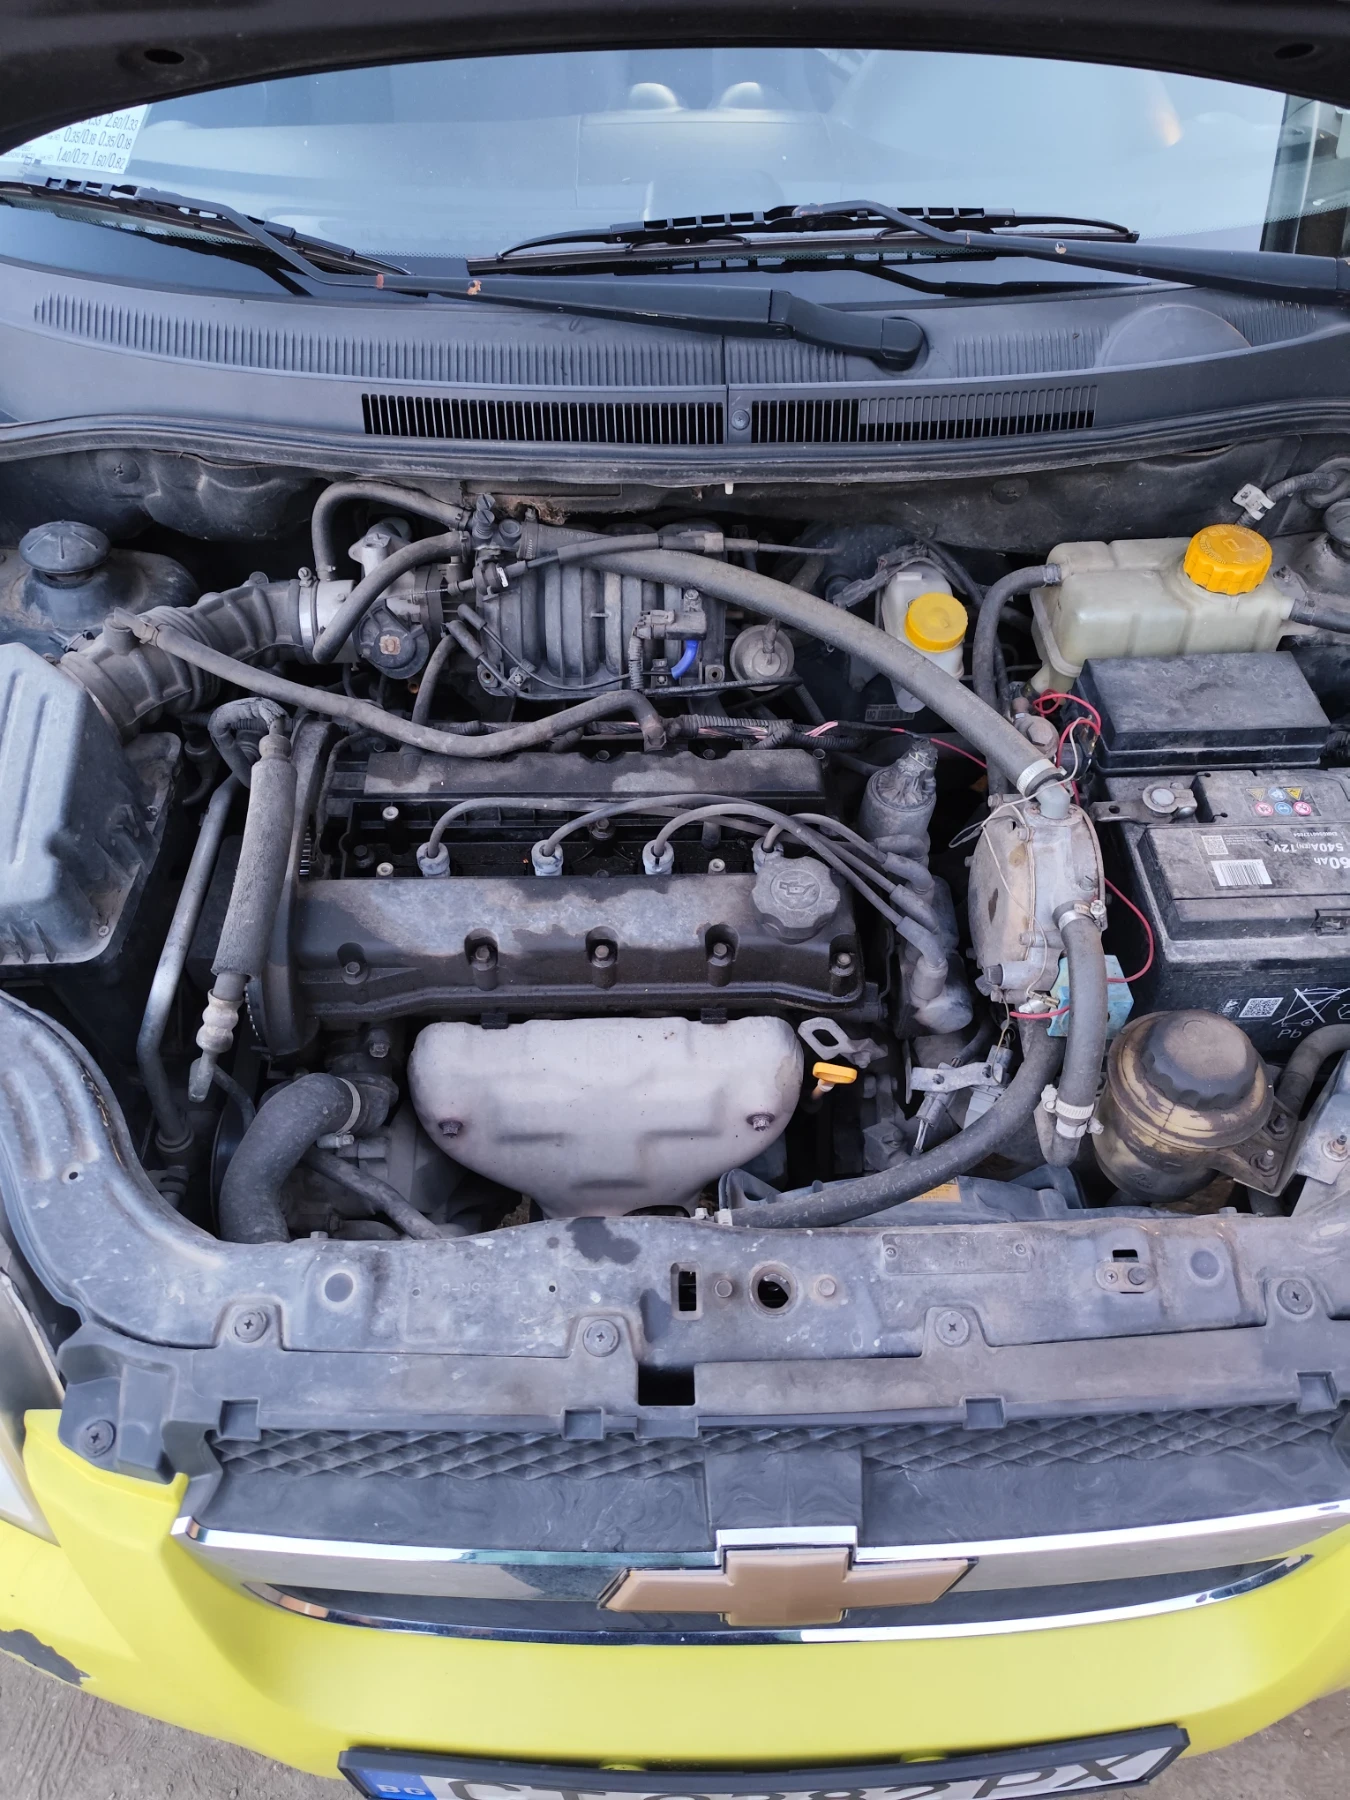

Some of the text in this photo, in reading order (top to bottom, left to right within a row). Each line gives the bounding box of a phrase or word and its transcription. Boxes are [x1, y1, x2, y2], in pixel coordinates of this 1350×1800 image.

[63, 126, 132, 150] 0.35/0.18 0.35/0.18
[57, 146, 89, 165] 1.40/0.72
[1277, 1028, 1302, 1039] Pb
[973, 1750, 1150, 1798] PX
[376, 1783, 426, 1796] BG
